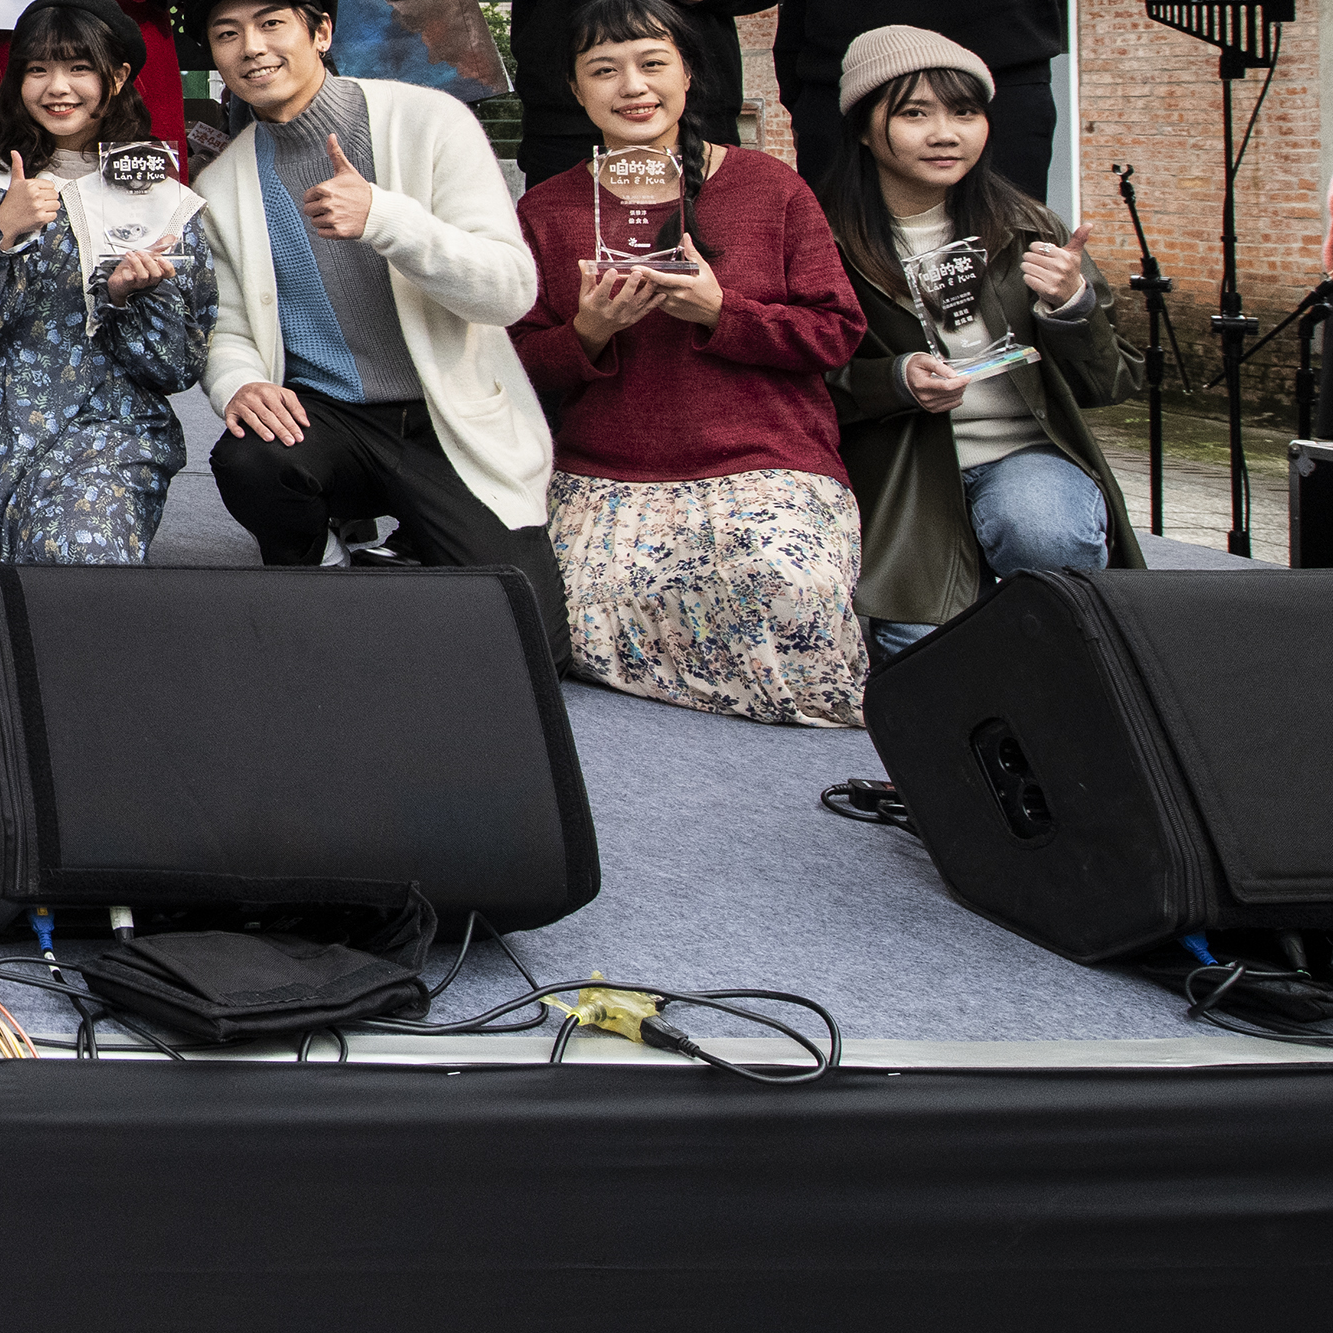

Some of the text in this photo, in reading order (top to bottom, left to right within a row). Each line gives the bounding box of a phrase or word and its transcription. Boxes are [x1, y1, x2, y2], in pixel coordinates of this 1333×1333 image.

[113, 155, 165, 171] 咱的歌
[609, 159, 666, 176] 咱的歌
[610, 176, 630, 185] Lán
[645, 176, 666, 185] Kua
